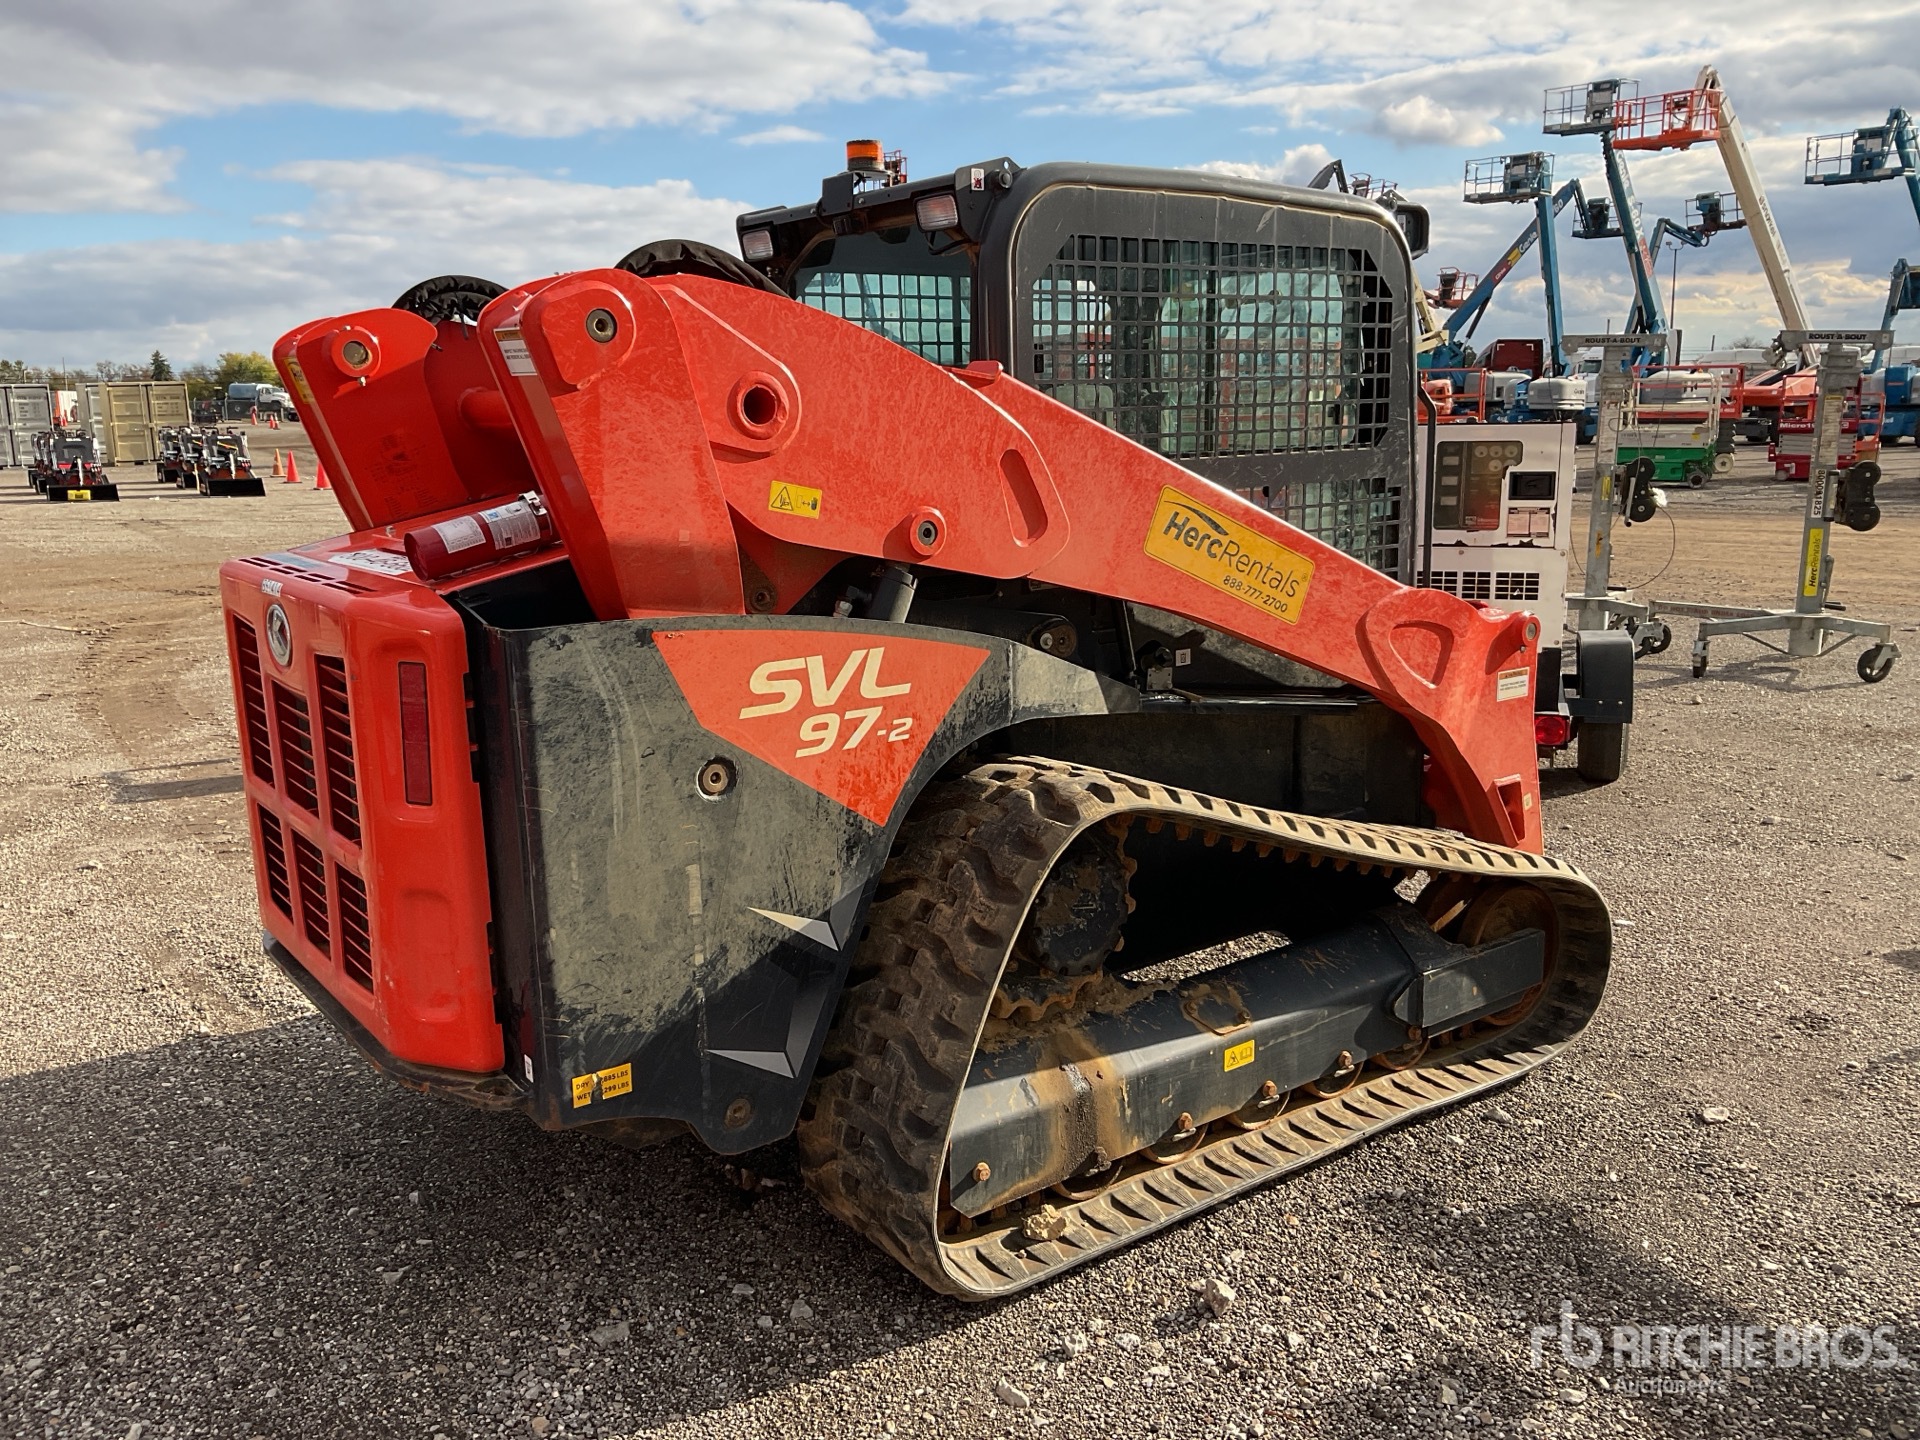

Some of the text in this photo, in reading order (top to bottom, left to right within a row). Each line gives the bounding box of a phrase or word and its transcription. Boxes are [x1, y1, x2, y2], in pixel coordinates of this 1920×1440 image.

[1808, 537, 1822, 588] HercRentals
[1223, 575, 1289, 613] 888-777-2700
[739, 646, 912, 720] SVL
[795, 705, 913, 758] 97-2
[576, 1081, 589, 1090] DRY
[602, 1073, 616, 1083] ,885
[577, 1081, 630, 1101] WET 299 LBS
